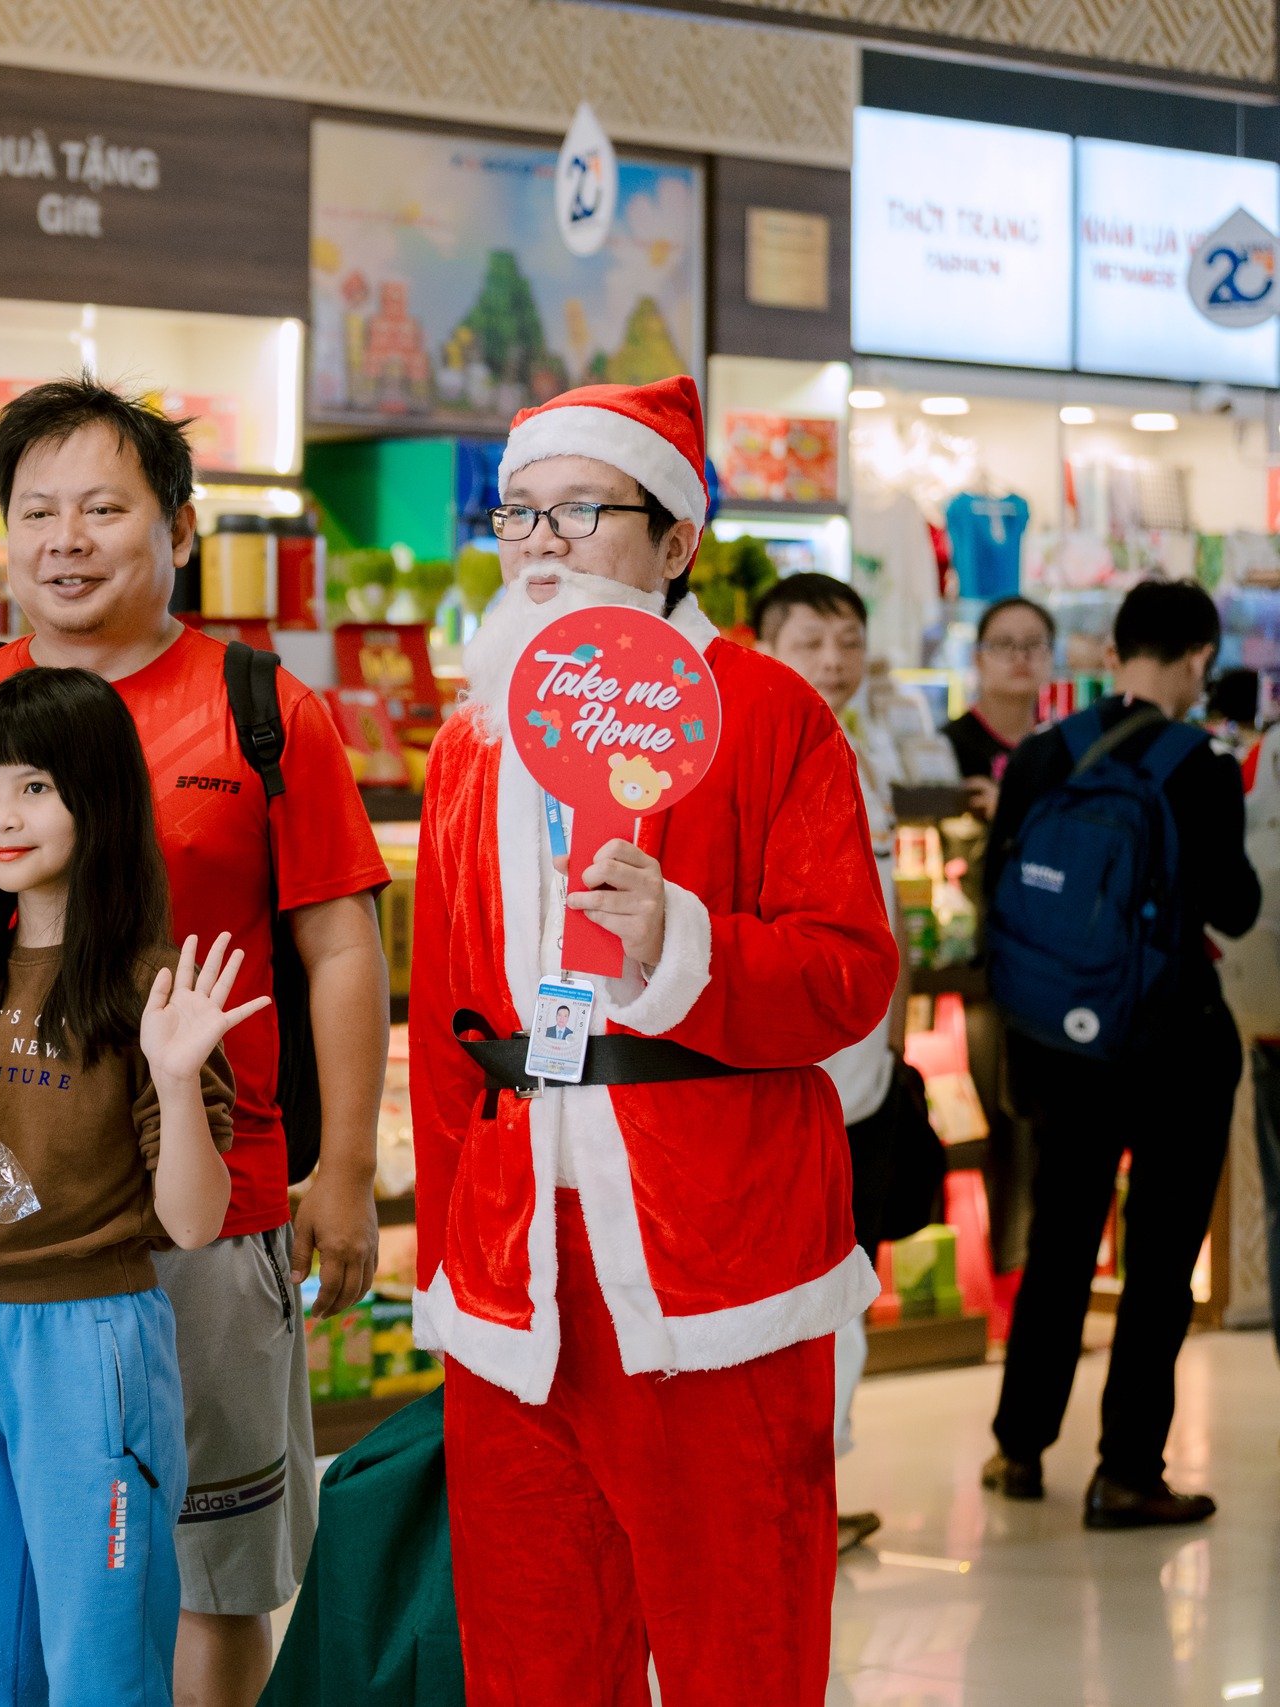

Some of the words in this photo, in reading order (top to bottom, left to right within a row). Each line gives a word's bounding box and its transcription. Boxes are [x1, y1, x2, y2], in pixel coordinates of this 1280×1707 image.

[36, 193, 103, 239] Gift
[534, 650, 622, 702] Take
[625, 681, 681, 711] me
[571, 701, 675, 754] Home
[175, 775, 242, 795] SPORTS
[11, 1037, 61, 1060] NEW
[181, 1493, 237, 1514] didas
[107, 1497, 128, 1570] KELME
